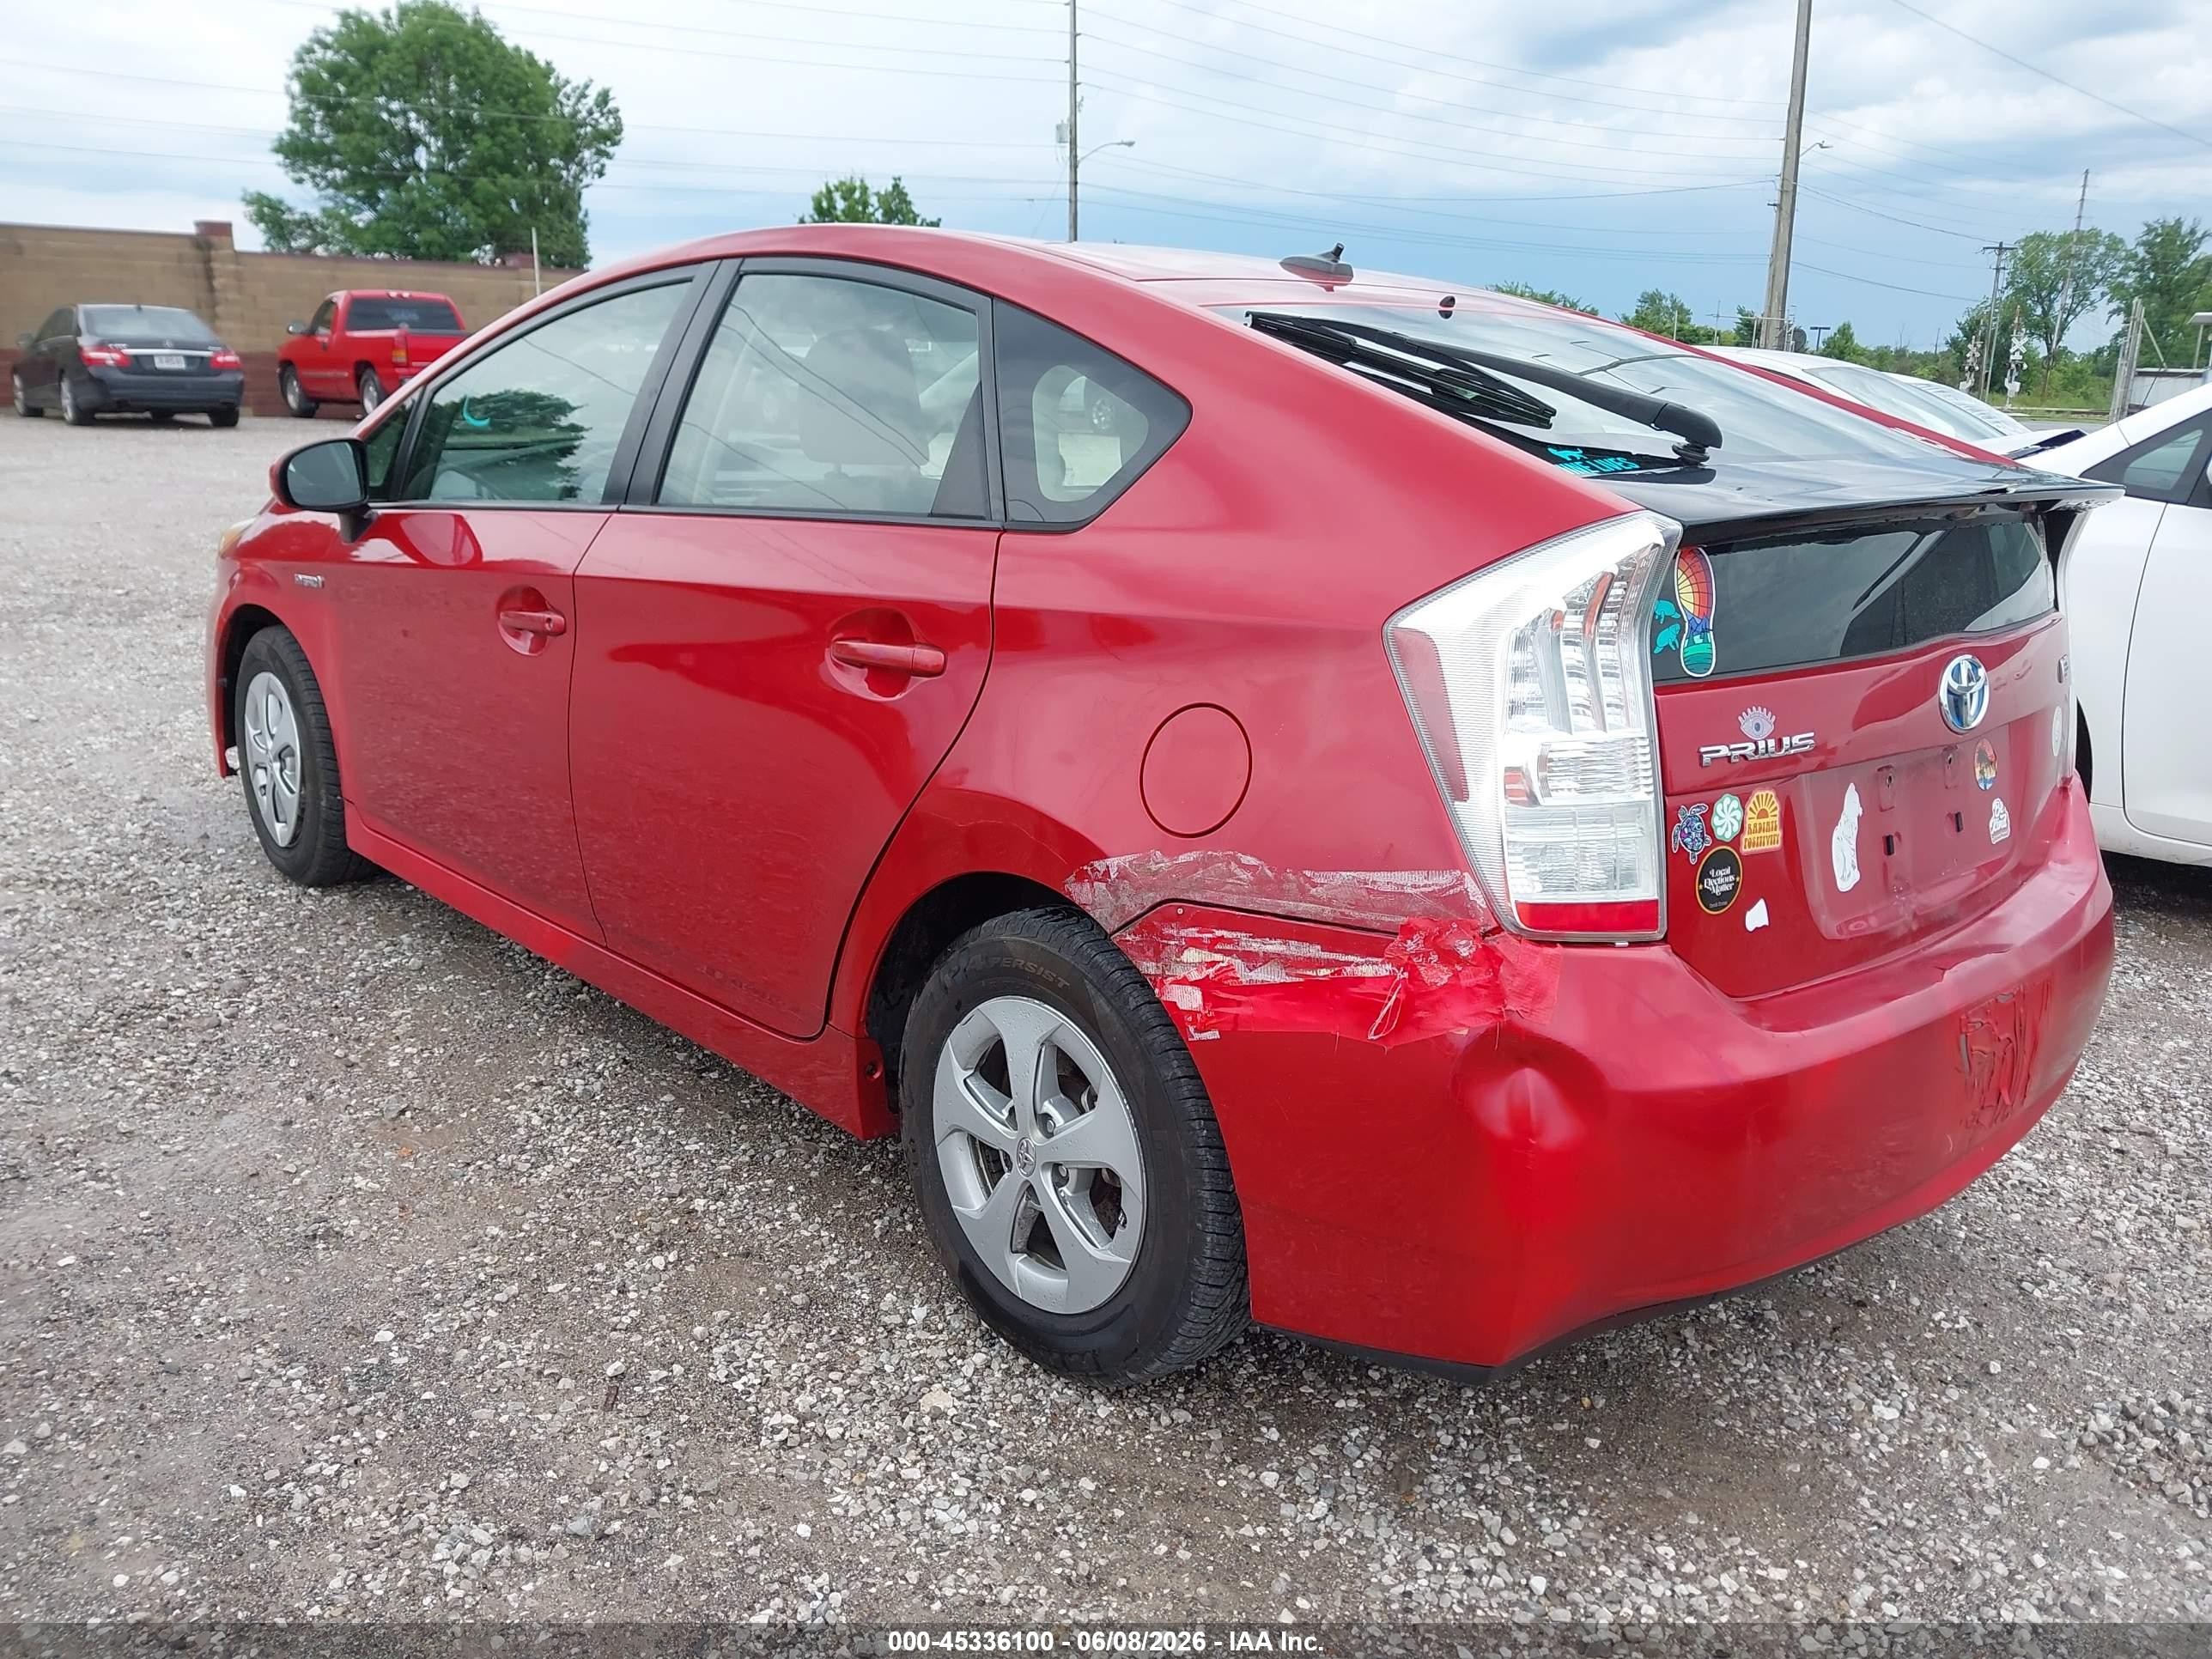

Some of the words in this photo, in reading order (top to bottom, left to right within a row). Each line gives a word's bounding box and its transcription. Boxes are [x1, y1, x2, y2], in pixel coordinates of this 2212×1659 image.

[1585, 457, 1640, 473] LIVES
[1698, 732, 1815, 767] PRIUS
[1747, 820, 1778, 836] RADIATE
[1744, 833, 1780, 849] POSITIVITY
[1709, 866, 1731, 878] Local
[1704, 874, 1735, 891] Elections
[1711, 883, 1735, 896] Matter
[988, 957, 1071, 988] PERSIST
